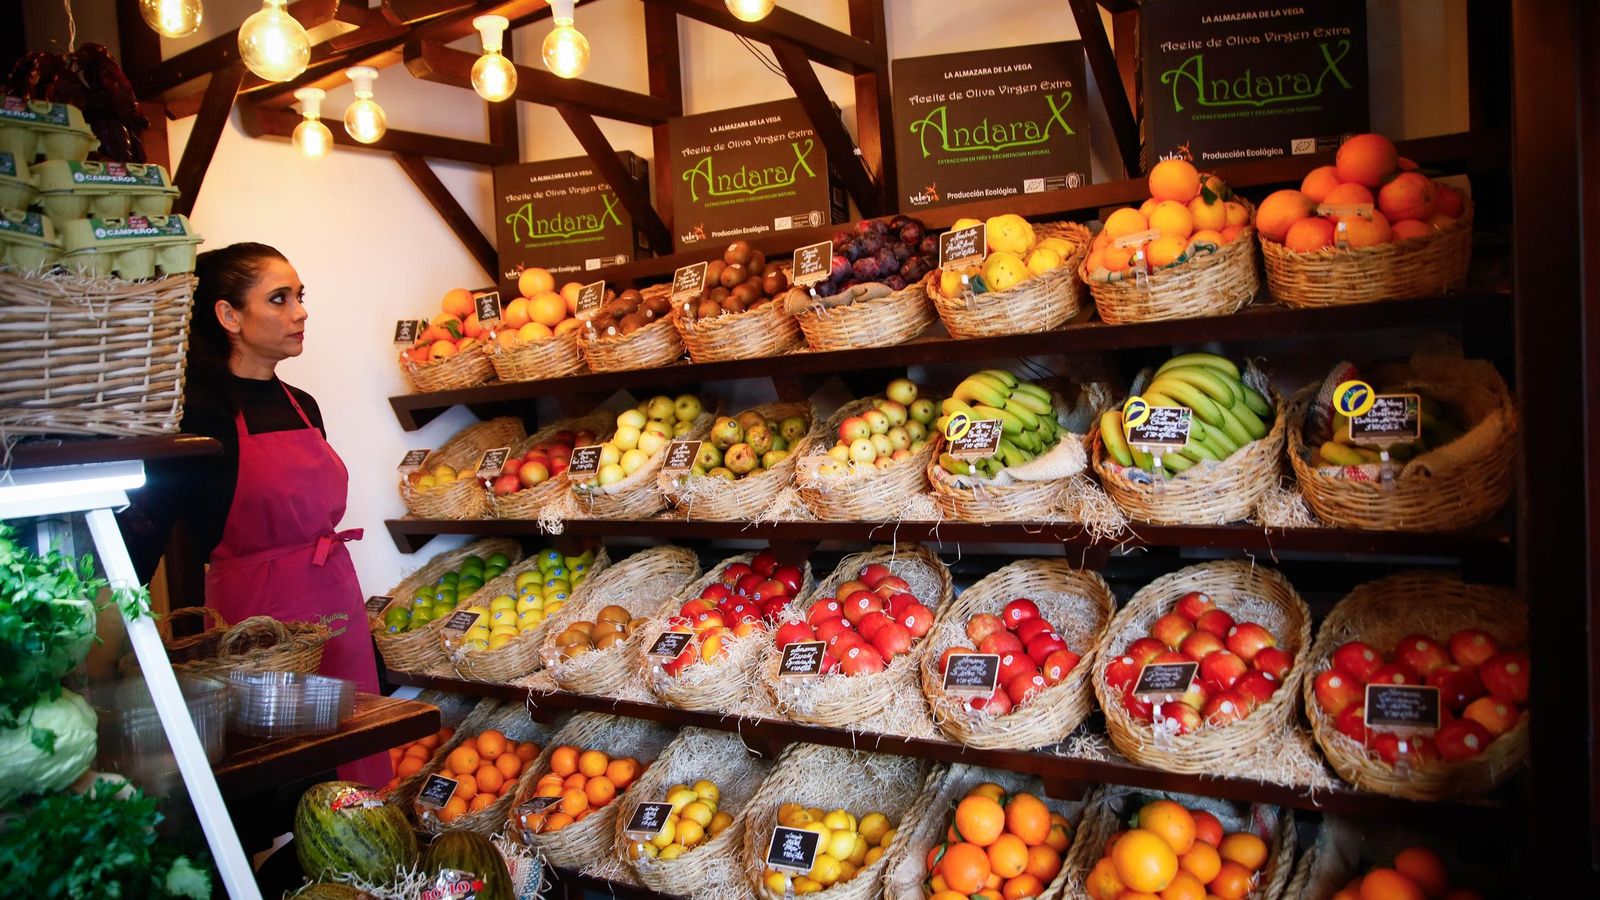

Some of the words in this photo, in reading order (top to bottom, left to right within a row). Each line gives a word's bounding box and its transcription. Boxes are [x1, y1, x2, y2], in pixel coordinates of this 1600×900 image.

[1201, 16, 1212, 24] LA
[1212, 12, 1257, 23] ALMAZARA
[1258, 10, 1269, 19] DE
[1282, 7, 1305, 17] VEGA
[1160, 39, 1203, 53] Aceite
[1206, 36, 1223, 49] de
[1226, 34, 1260, 48] Oliva
[1264, 31, 1310, 44] Virgen
[1313, 26, 1351, 39] Extra
[944, 72, 953, 80] LA
[953, 68, 993, 78] ALMAZARA
[993, 66, 1002, 74] DE
[1003, 65, 1012, 73] LA
[1013, 63, 1032, 72] VEGA
[909, 93, 946, 106] Aceite
[949, 90, 963, 102] de
[966, 88, 995, 99] Oliva
[998, 84, 1037, 96] Virgen
[1040, 79, 1072, 91] Extra
[718, 121, 749, 132] ALMAZARA
[766, 116, 781, 124] VEGA
[681, 147, 711, 157] Aceite
[714, 143, 725, 152] de
[728, 139, 751, 149] Oliva
[754, 134, 785, 145] Virgen
[787, 129, 813, 139] Extra
[1202, 149, 1245, 161] Producción
[1246, 147, 1284, 159] Ecológica
[85, 174, 137, 183] CAMPEROS
[538, 172, 564, 182] ALMAZARA
[505, 193, 532, 203] Aceite
[533, 190, 544, 199] de
[545, 188, 567, 197] Oliva
[568, 185, 596, 195] Virgen
[947, 187, 985, 200] Producción
[985, 186, 1018, 197] Ecológica
[107, 227, 159, 236] CAMPEROS
[743, 225, 770, 235] Ecológica
